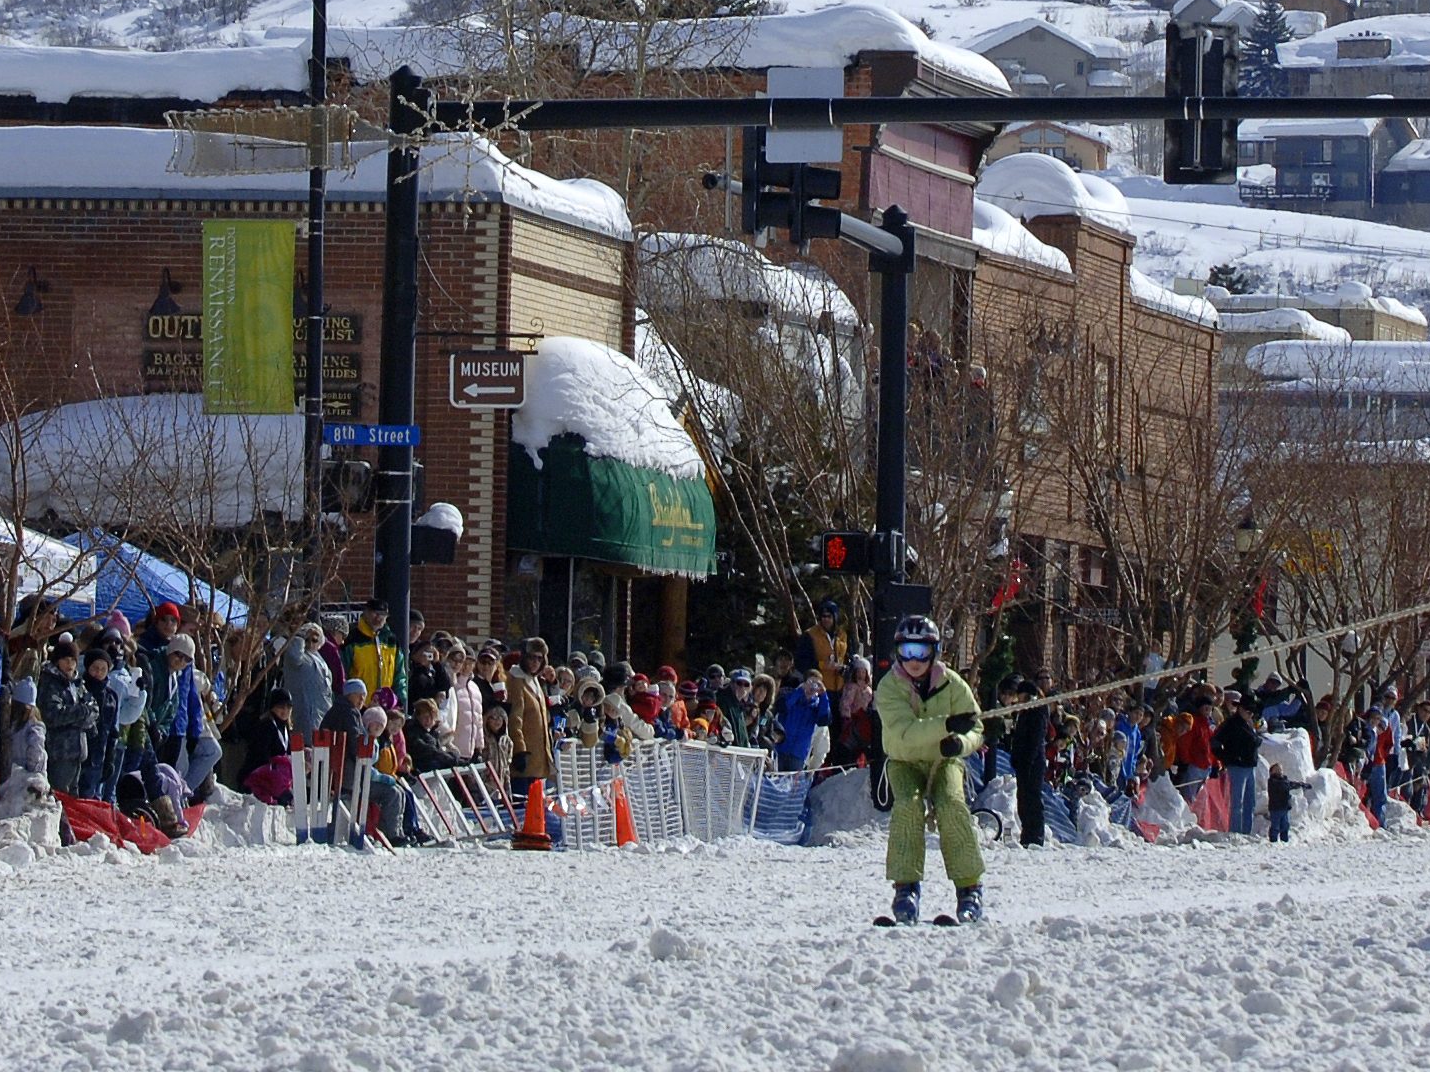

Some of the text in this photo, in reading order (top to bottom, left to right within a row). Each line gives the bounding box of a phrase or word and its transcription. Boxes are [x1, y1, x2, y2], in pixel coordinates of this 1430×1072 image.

[227, 226, 236, 305] DOWNTOWN
[208, 235, 226, 392] RENAISSANCE
[460, 361, 520, 377] MUSEUM
[334, 425, 410, 443] 8th Street
